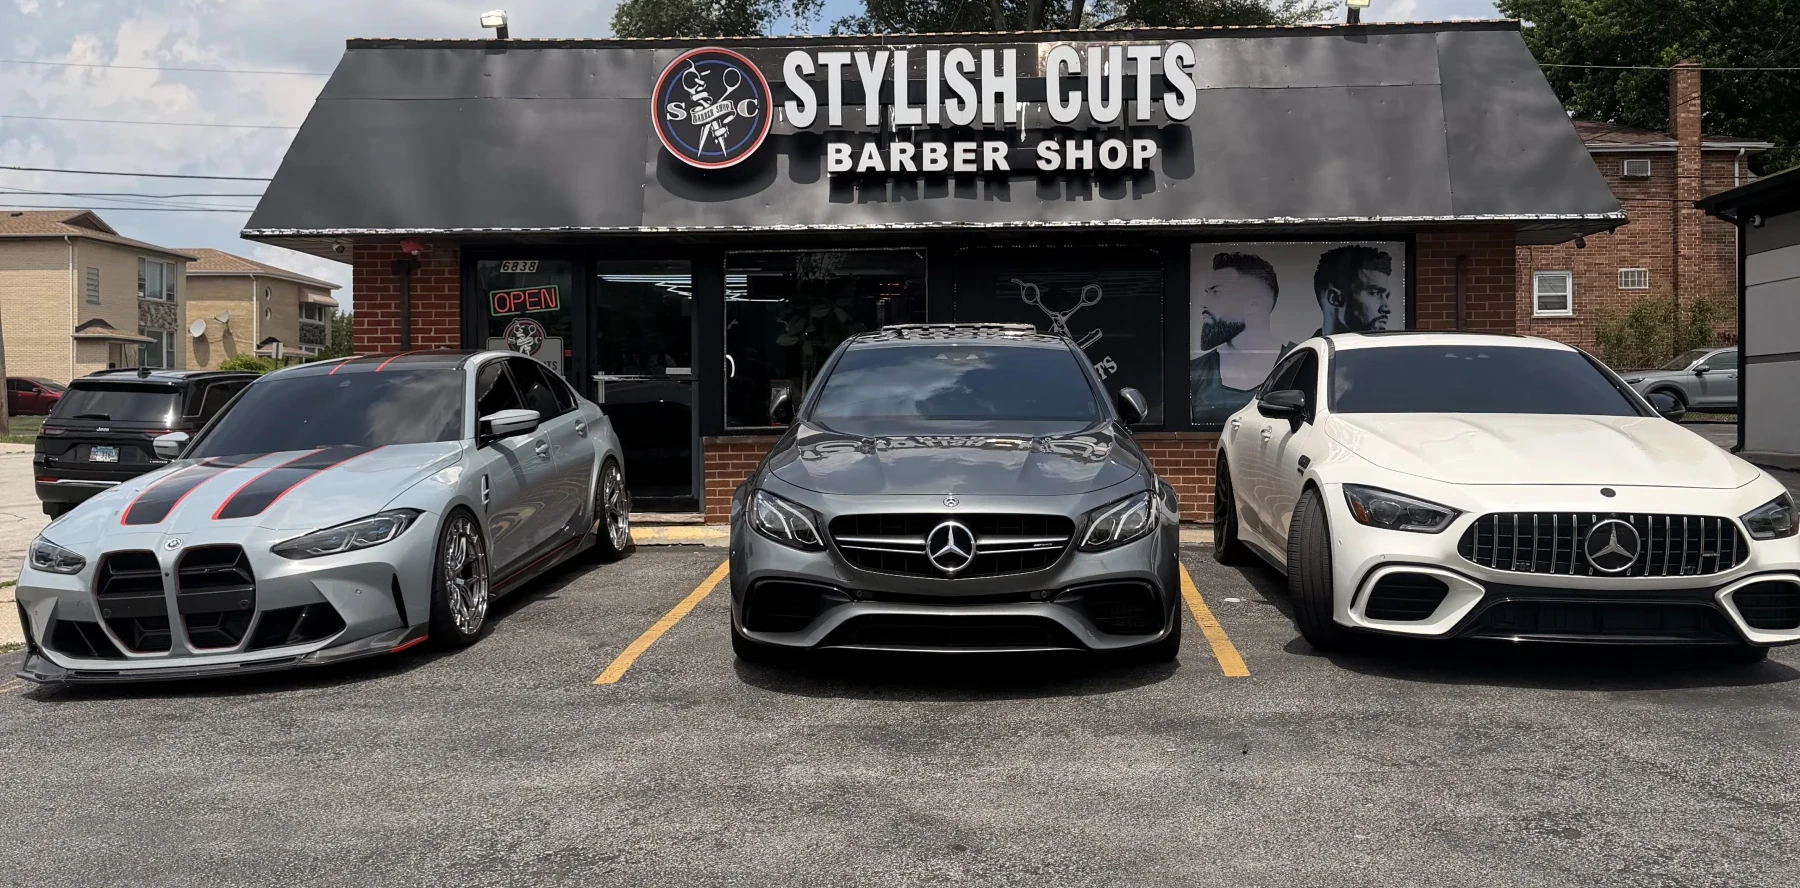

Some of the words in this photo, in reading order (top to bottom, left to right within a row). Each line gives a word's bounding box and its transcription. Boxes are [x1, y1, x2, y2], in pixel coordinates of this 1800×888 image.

[782, 47, 1018, 129] STYLISH
[1045, 41, 1198, 125] CUTS
[827, 140, 1012, 173] BARBER
[1036, 138, 1158, 171] SHOP
[502, 261, 536, 271] 6838
[494, 288, 556, 313] OPEN
[1094, 355, 1118, 380] TS
